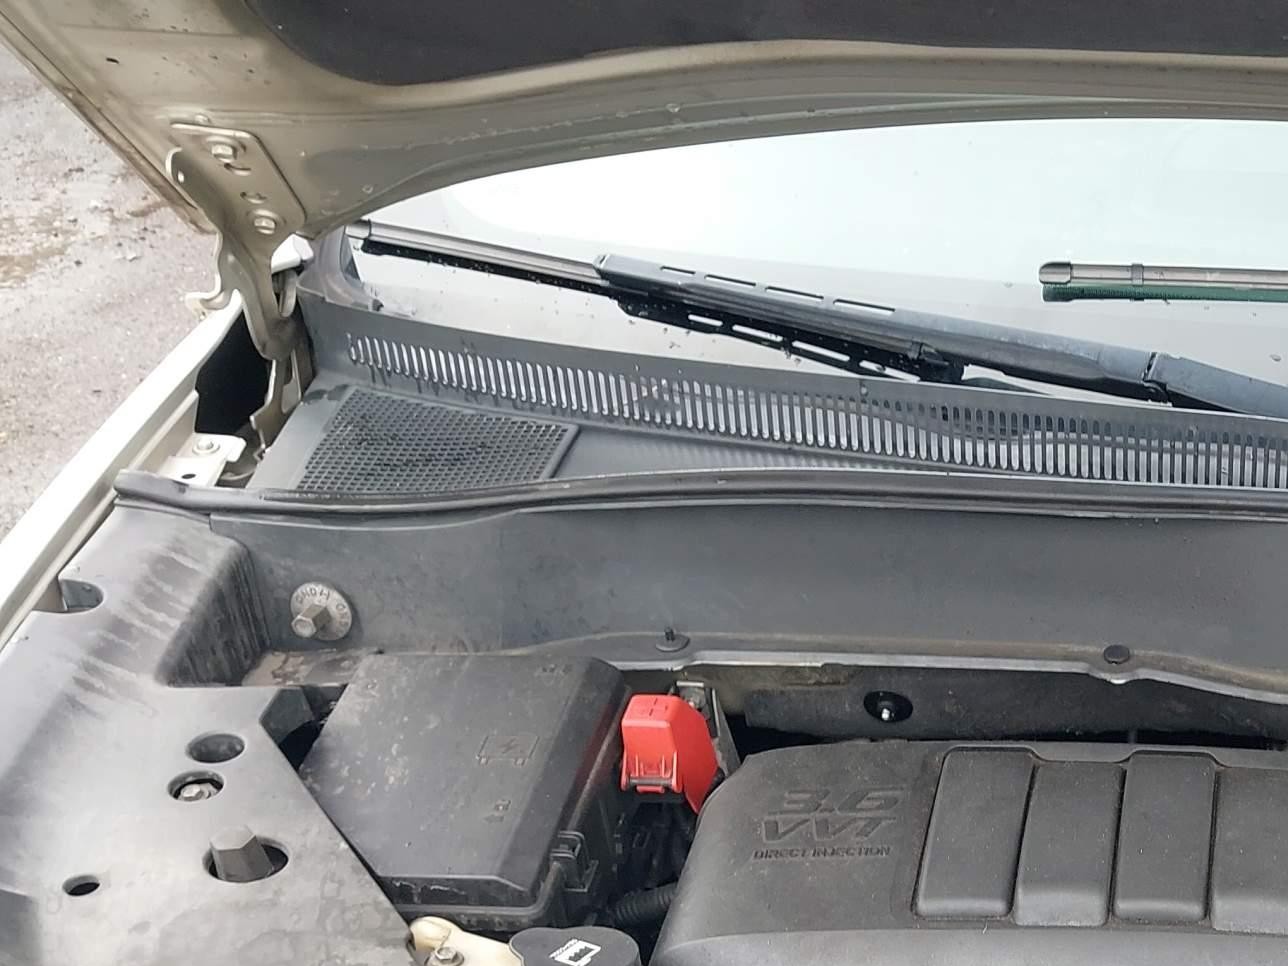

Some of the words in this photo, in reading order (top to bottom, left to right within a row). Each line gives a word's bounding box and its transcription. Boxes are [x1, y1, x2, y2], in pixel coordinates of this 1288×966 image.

[761, 814, 897, 844] VVT
[752, 848, 807, 860] DIRECT
[811, 846, 891, 858] INJECTION
